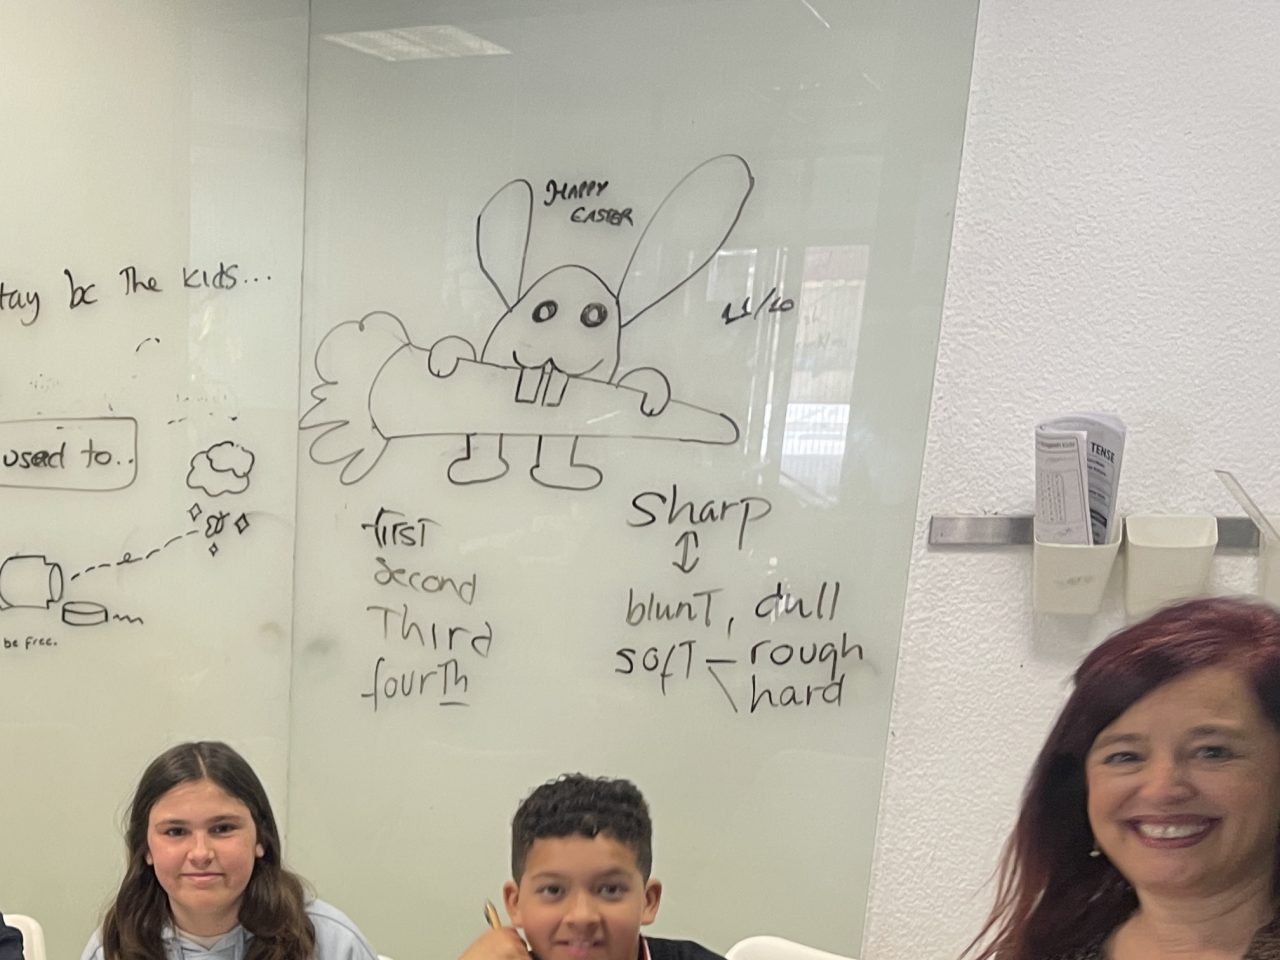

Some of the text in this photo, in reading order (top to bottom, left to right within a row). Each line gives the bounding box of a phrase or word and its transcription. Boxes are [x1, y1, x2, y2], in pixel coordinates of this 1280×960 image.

[3, 442, 66, 469] used
[1090, 442, 1115, 463] TENSE
[755, 582, 840, 620] dull
[3, 637, 18, 649] be
[751, 632, 863, 681] rough
[750, 673, 845, 713] hard
